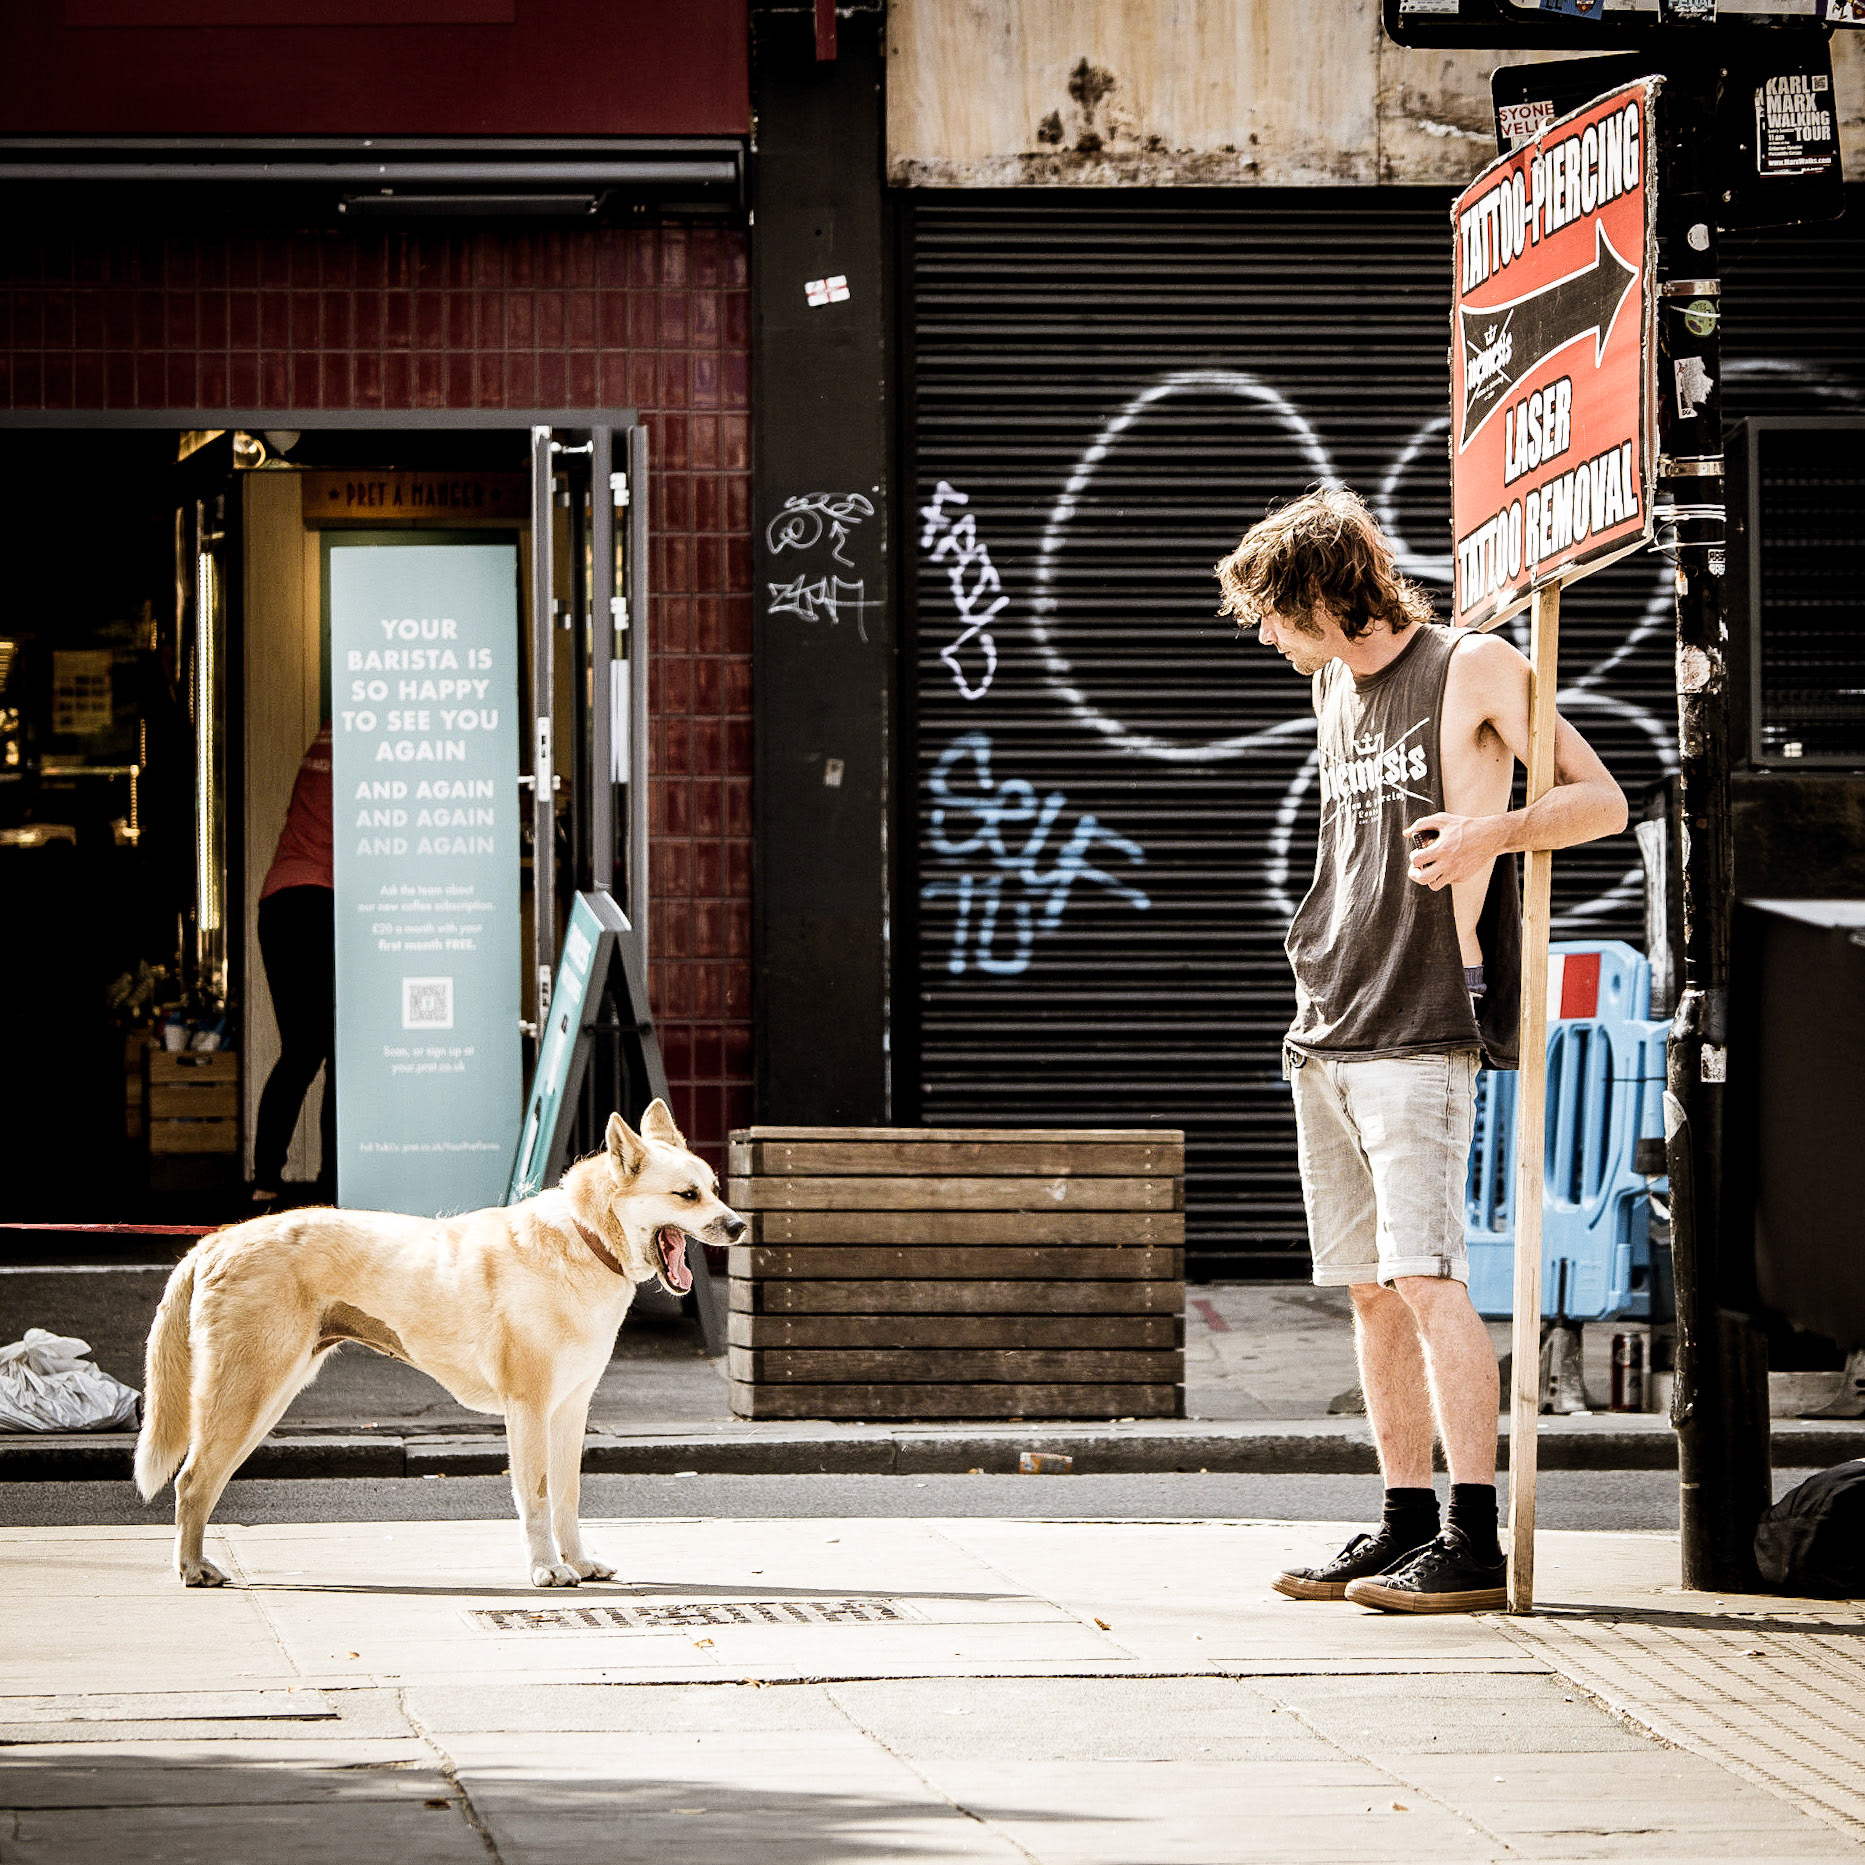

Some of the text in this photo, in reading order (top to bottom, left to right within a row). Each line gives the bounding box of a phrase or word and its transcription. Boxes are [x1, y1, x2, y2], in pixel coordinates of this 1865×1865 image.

[1766, 75, 1811, 95] KARL
[1766, 93, 1817, 114] MARX
[1767, 110, 1831, 128] WALKING
[1794, 125, 1831, 141] TOUR
[1505, 377, 1572, 487] LASER
[345, 482, 386, 506] PRET
[411, 482, 484, 507] MANGER
[1458, 441, 1639, 615] TATTOO REMOVAL
[381, 618, 458, 641] YOUR
[347, 648, 493, 671] BARISTA IS
[351, 679, 490, 702] SO HAPPY
[341, 709, 500, 733] TO SEE YOU
[375, 740, 466, 763] AGAIN
[355, 779, 495, 800] AND AGAIN
[356, 808, 495, 828] AND AGAIN
[356, 836, 495, 856] AND AGAIN
[380, 883, 474, 896] Ask the team about
[358, 903, 376, 912] our
[378, 903, 399, 912] new
[401, 899, 432, 913] coffee
[404, 922, 435, 935] month
[459, 924, 483, 937] your
[378, 938, 402, 951] first
[404, 938, 443, 951] month
[448, 1047, 462, 1059] up
